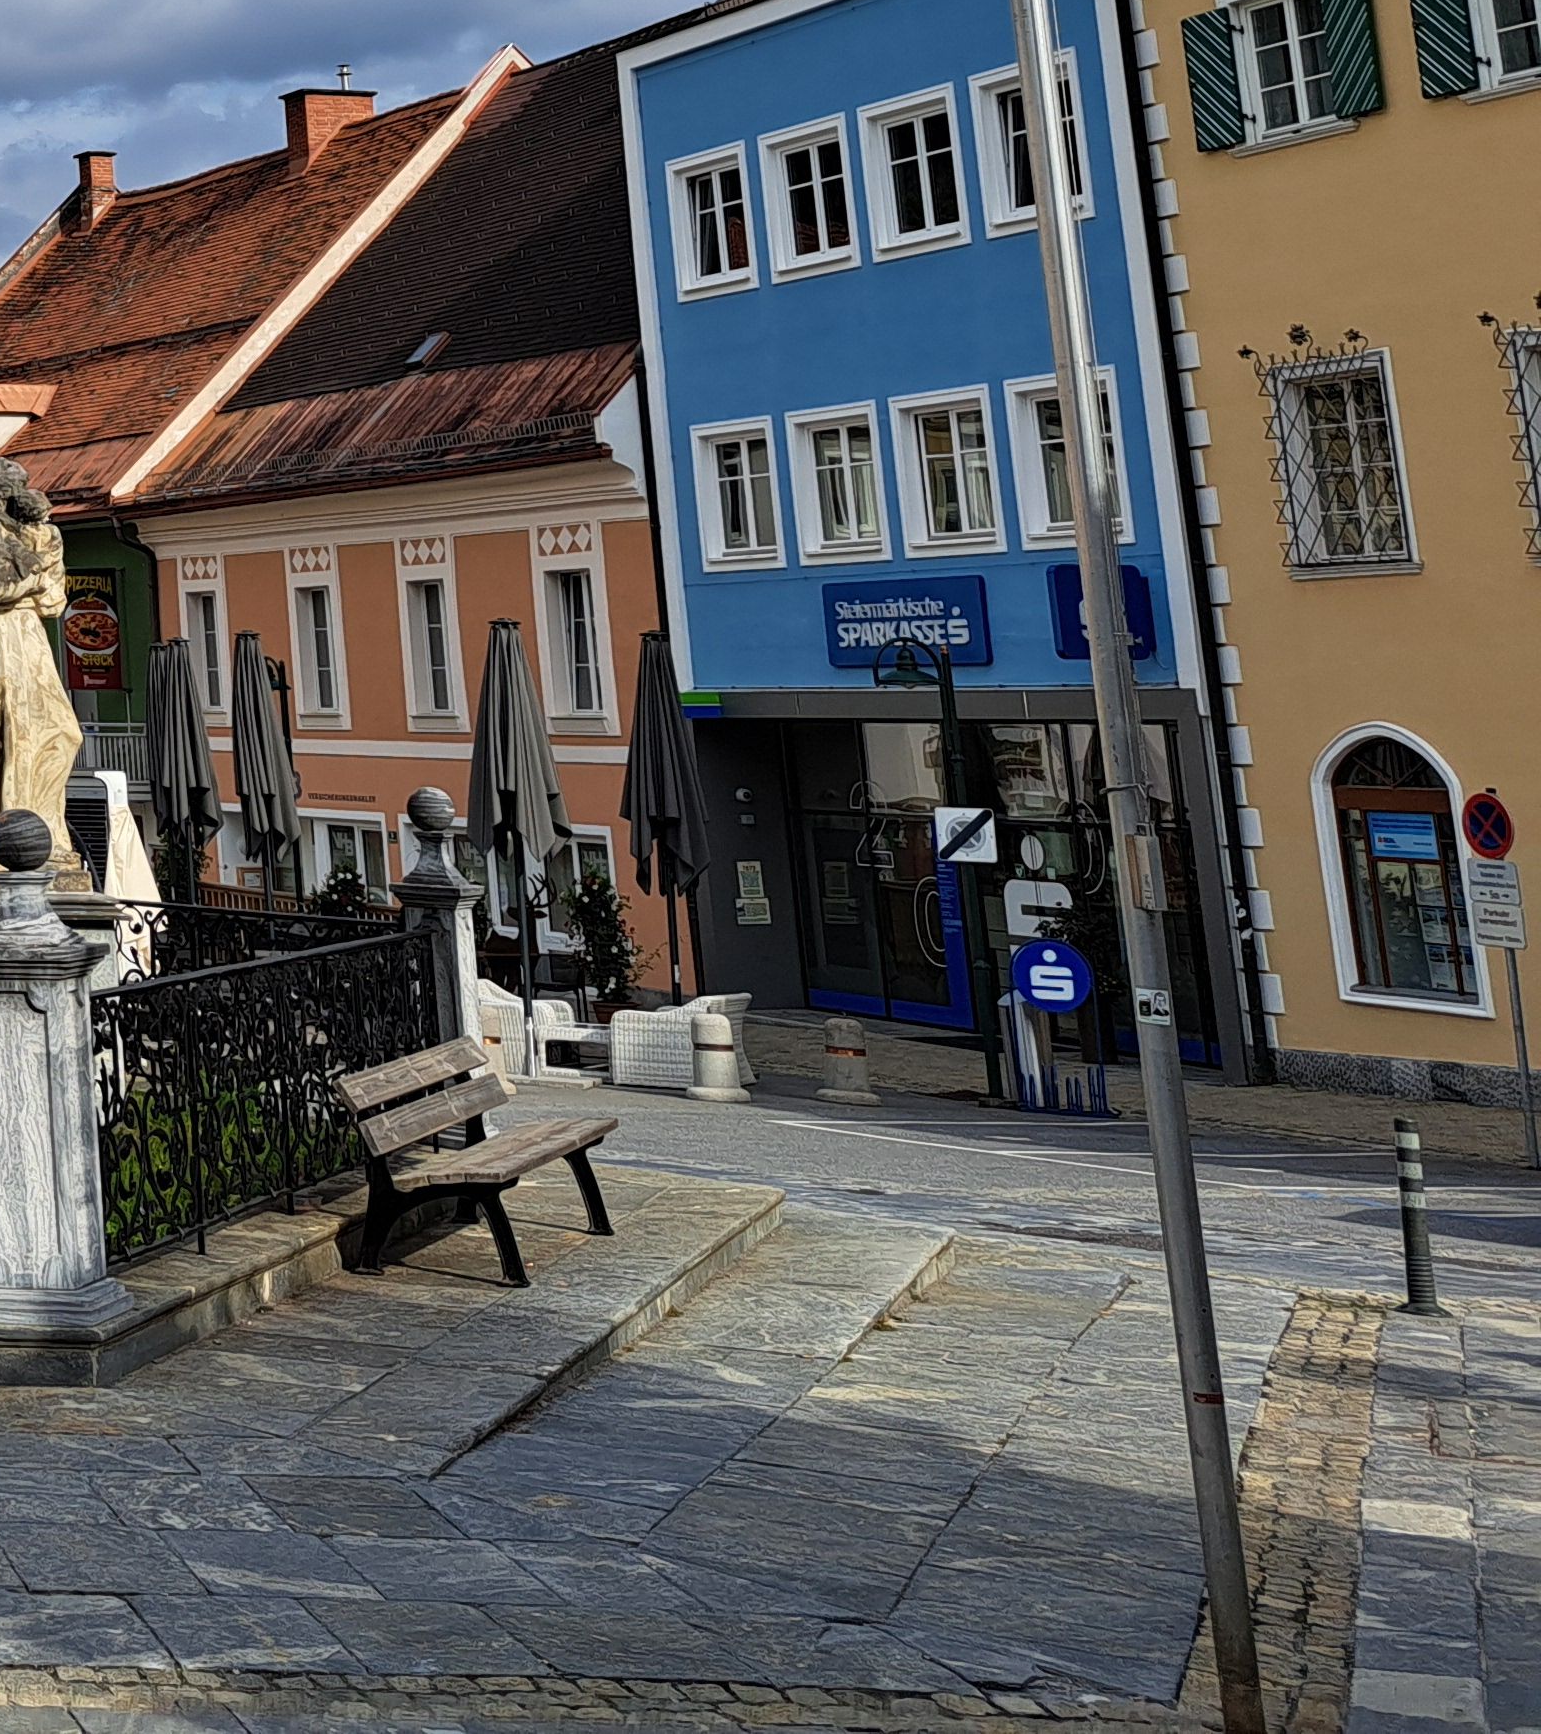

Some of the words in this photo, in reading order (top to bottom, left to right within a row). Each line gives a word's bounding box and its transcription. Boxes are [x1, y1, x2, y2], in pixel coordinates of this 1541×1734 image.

[66, 576, 114, 596] PIZZERIA
[834, 596, 946, 620] Steiermärkische
[837, 619, 949, 649] SPARKASSE
[82, 653, 115, 667] STOCK
